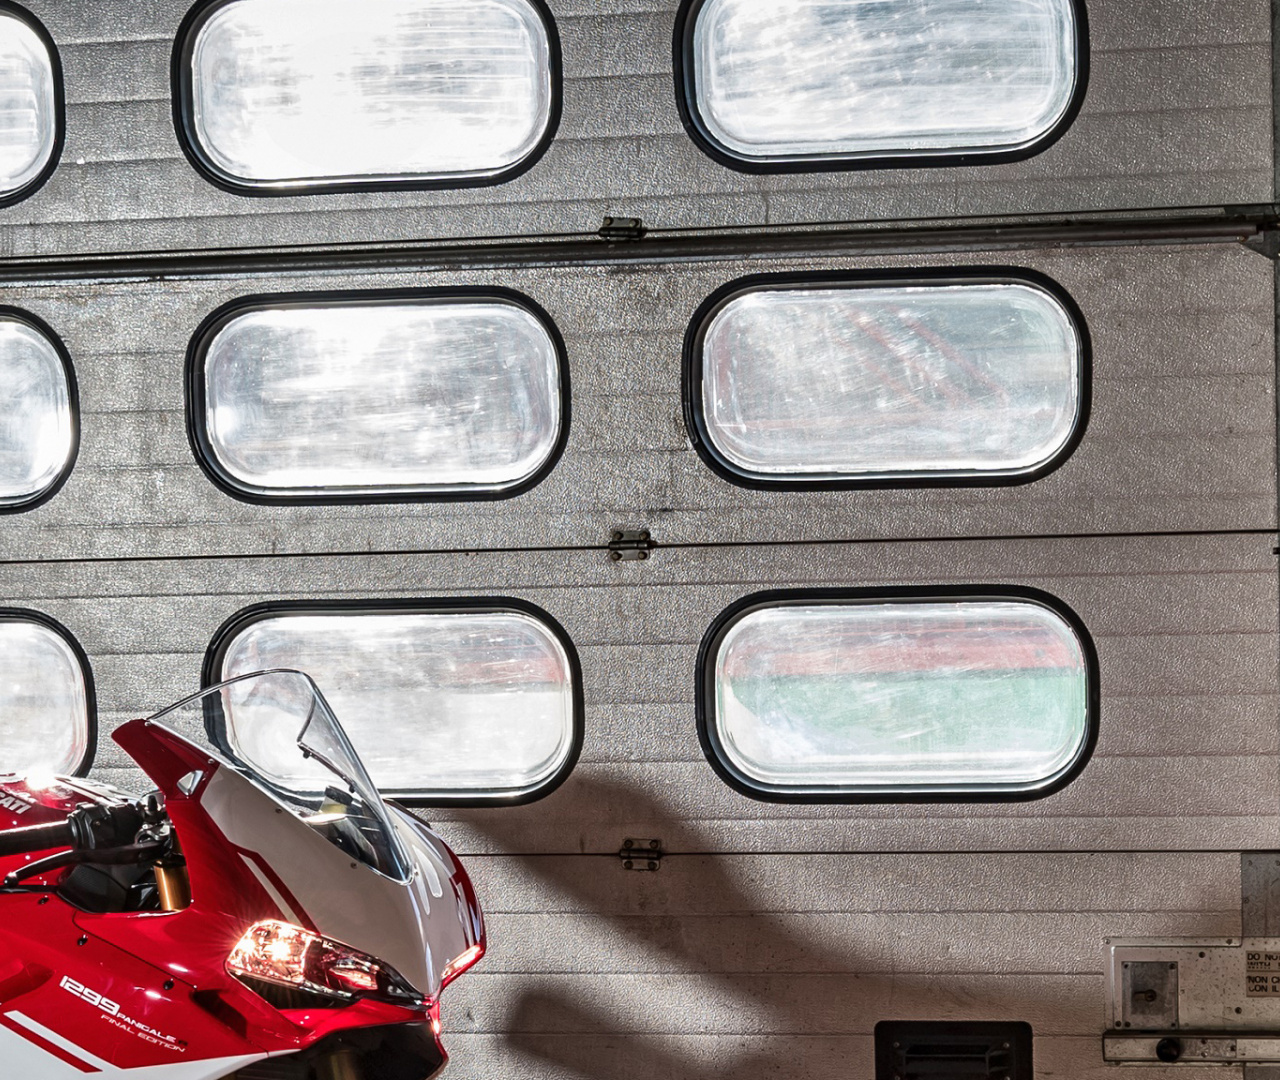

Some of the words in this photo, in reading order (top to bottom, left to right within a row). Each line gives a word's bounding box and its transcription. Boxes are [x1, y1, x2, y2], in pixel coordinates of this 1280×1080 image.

[1247, 953, 1261, 961] DO
[1247, 976, 1268, 984] NON
[1248, 985, 1268, 993] CON
[1272, 985, 1279, 993] IL
[59, 975, 121, 1016] 1299
[116, 1012, 177, 1043] PANIGALE
[100, 1014, 135, 1035] FINAL
[137, 1032, 186, 1053] EDITION
